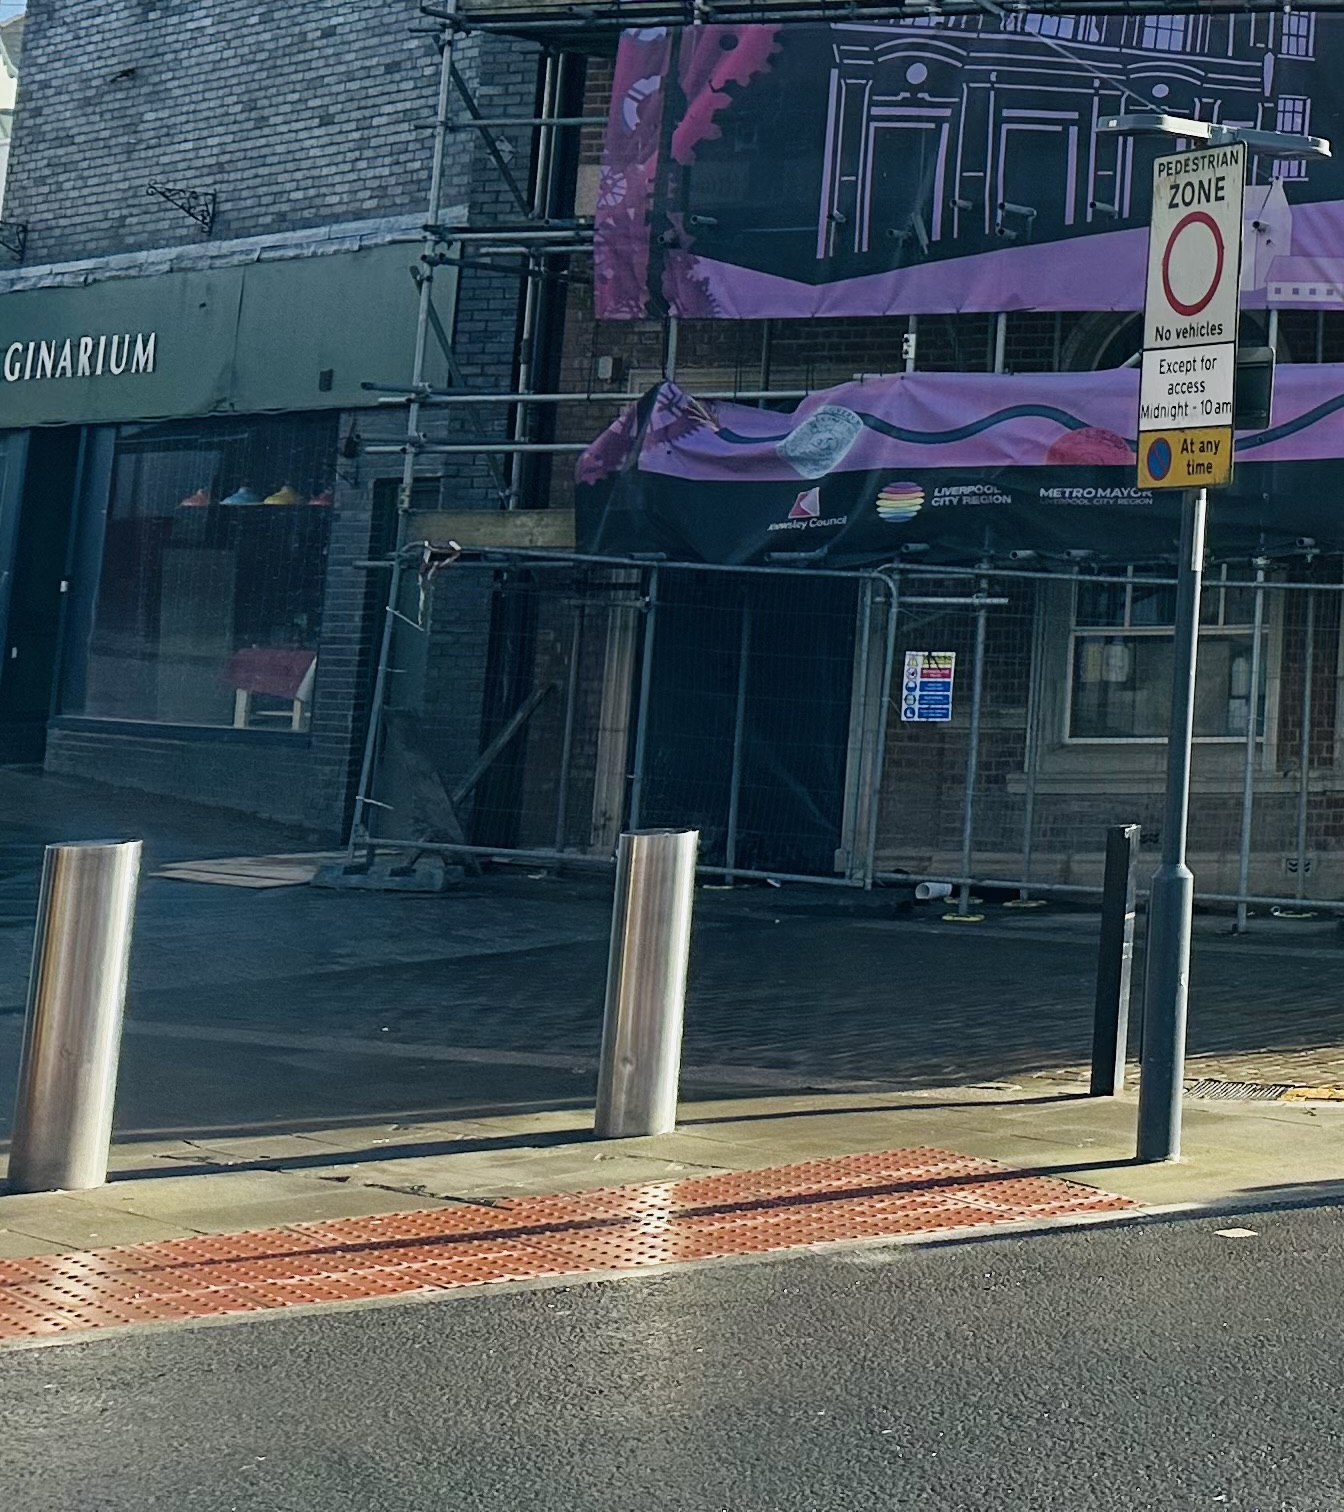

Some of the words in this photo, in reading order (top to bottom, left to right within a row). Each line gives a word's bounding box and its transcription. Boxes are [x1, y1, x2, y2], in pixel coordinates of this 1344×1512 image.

[1158, 149, 1239, 178] PEDESTRIAN
[1168, 176, 1226, 209] ZONE
[1155, 325, 1171, 342] No
[1175, 320, 1223, 339] vehicles
[4, 332, 157, 382] GINARIUM
[1159, 356, 1196, 375] Except
[1201, 355, 1217, 371] for
[1167, 380, 1206, 395] access
[1141, 401, 1188, 421] Midnight
[1181, 438, 1195, 454] At
[1199, 439, 1220, 455] any
[1187, 459, 1213, 476] time
[934, 485, 1001, 496] LIVERPOOL
[932, 496, 958, 506] CITY
[962, 495, 1012, 506] REGION
[1093, 497, 1116, 506] CITY
[1118, 497, 1153, 506] REGION
[809, 515, 848, 529] Council
